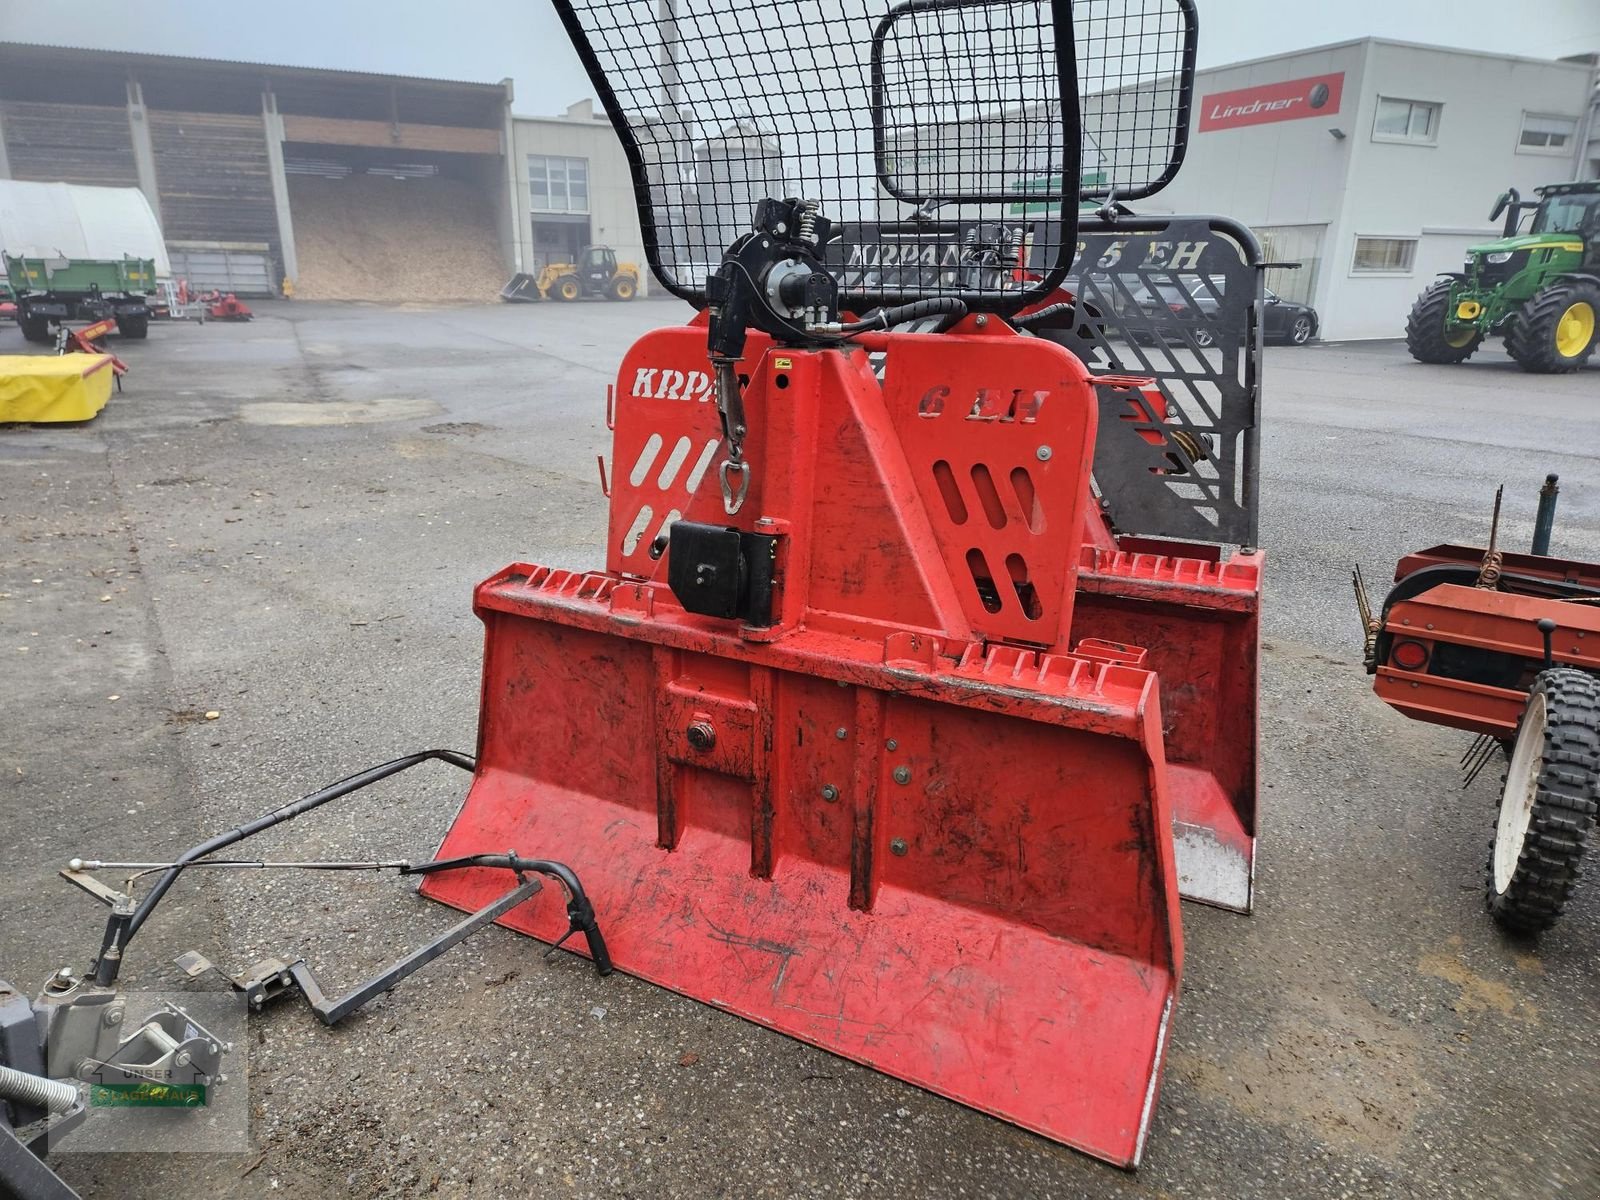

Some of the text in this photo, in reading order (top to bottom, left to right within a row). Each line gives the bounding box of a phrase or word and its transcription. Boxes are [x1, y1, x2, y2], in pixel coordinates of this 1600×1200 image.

[1210, 96, 1304, 120] Lindner
[1138, 240, 1209, 270] EH
[918, 384, 951, 419] 6
[963, 388, 1051, 425] EH
